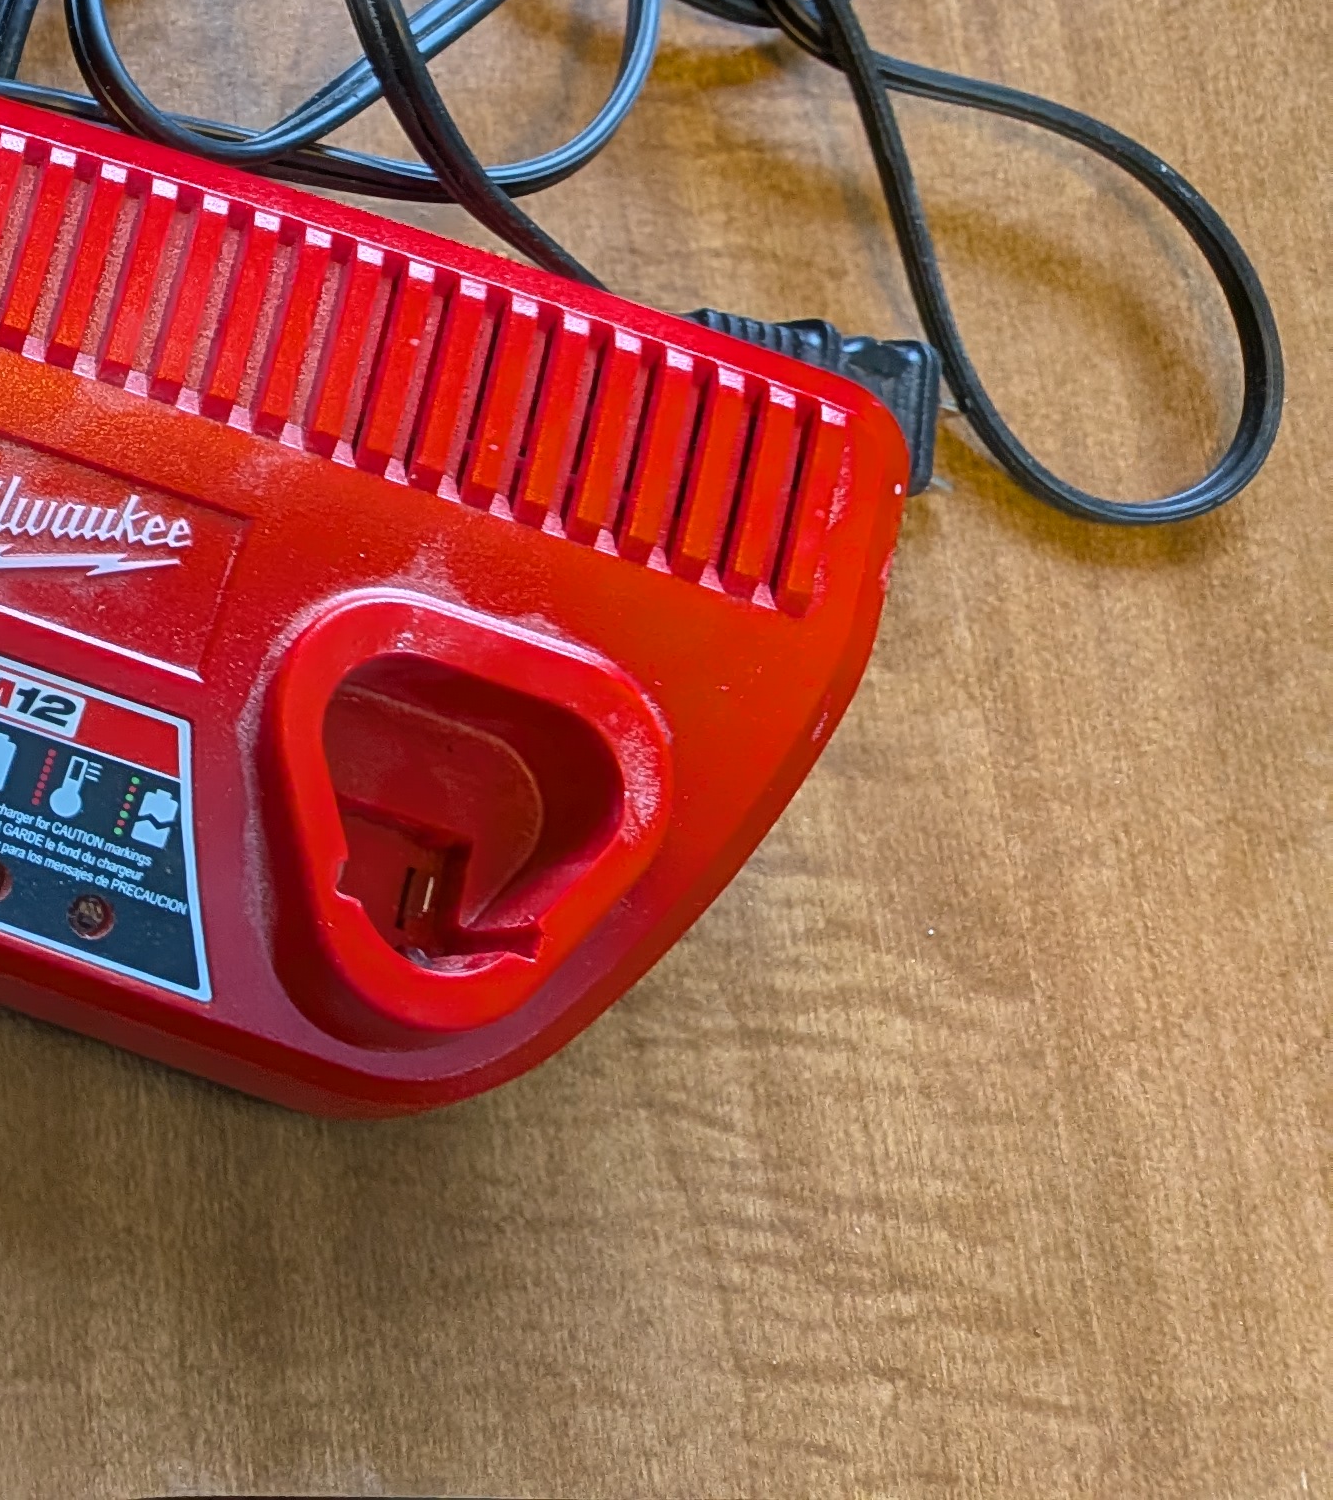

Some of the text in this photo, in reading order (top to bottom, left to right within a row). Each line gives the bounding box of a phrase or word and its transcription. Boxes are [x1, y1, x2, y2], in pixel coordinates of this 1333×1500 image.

[2, 822, 45, 849] GARDE
[56, 841, 82, 861] fond
[81, 851, 97, 867] du
[96, 857, 145, 882] chargeur
[35, 816, 51, 831] for
[51, 821, 105, 850] CAUTION
[104, 841, 153, 868] markings
[0, 843, 27, 860] para
[26, 849, 44, 866] los
[44, 857, 95, 883] mensajes
[94, 874, 110, 890] de
[109, 877, 189, 916] PRECAUCION
